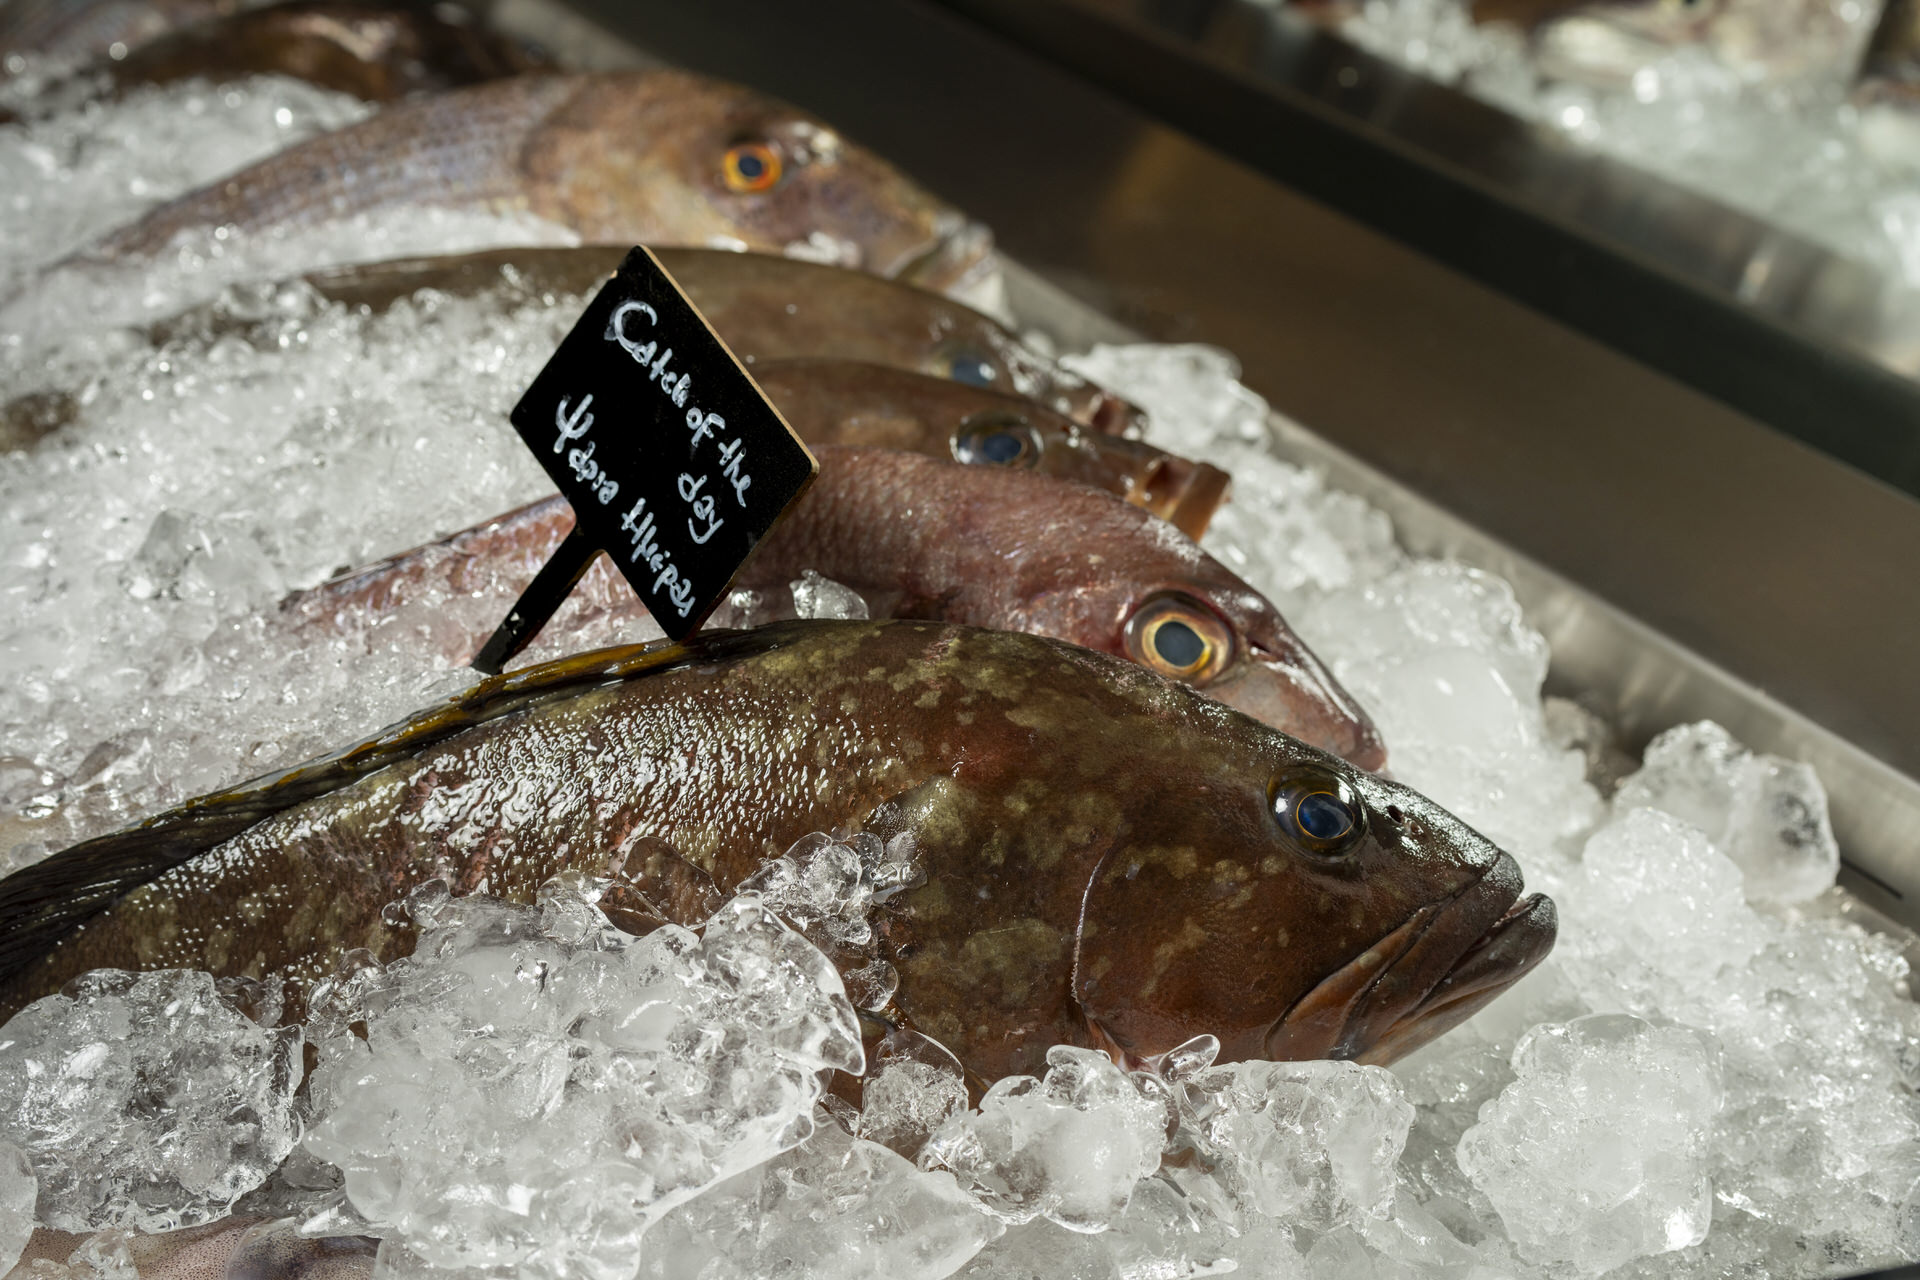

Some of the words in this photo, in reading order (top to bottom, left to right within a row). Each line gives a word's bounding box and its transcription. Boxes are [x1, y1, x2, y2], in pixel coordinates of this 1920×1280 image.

[605, 300, 690, 408] Catch
[718, 437, 751, 507] the
[678, 473, 724, 544] day
